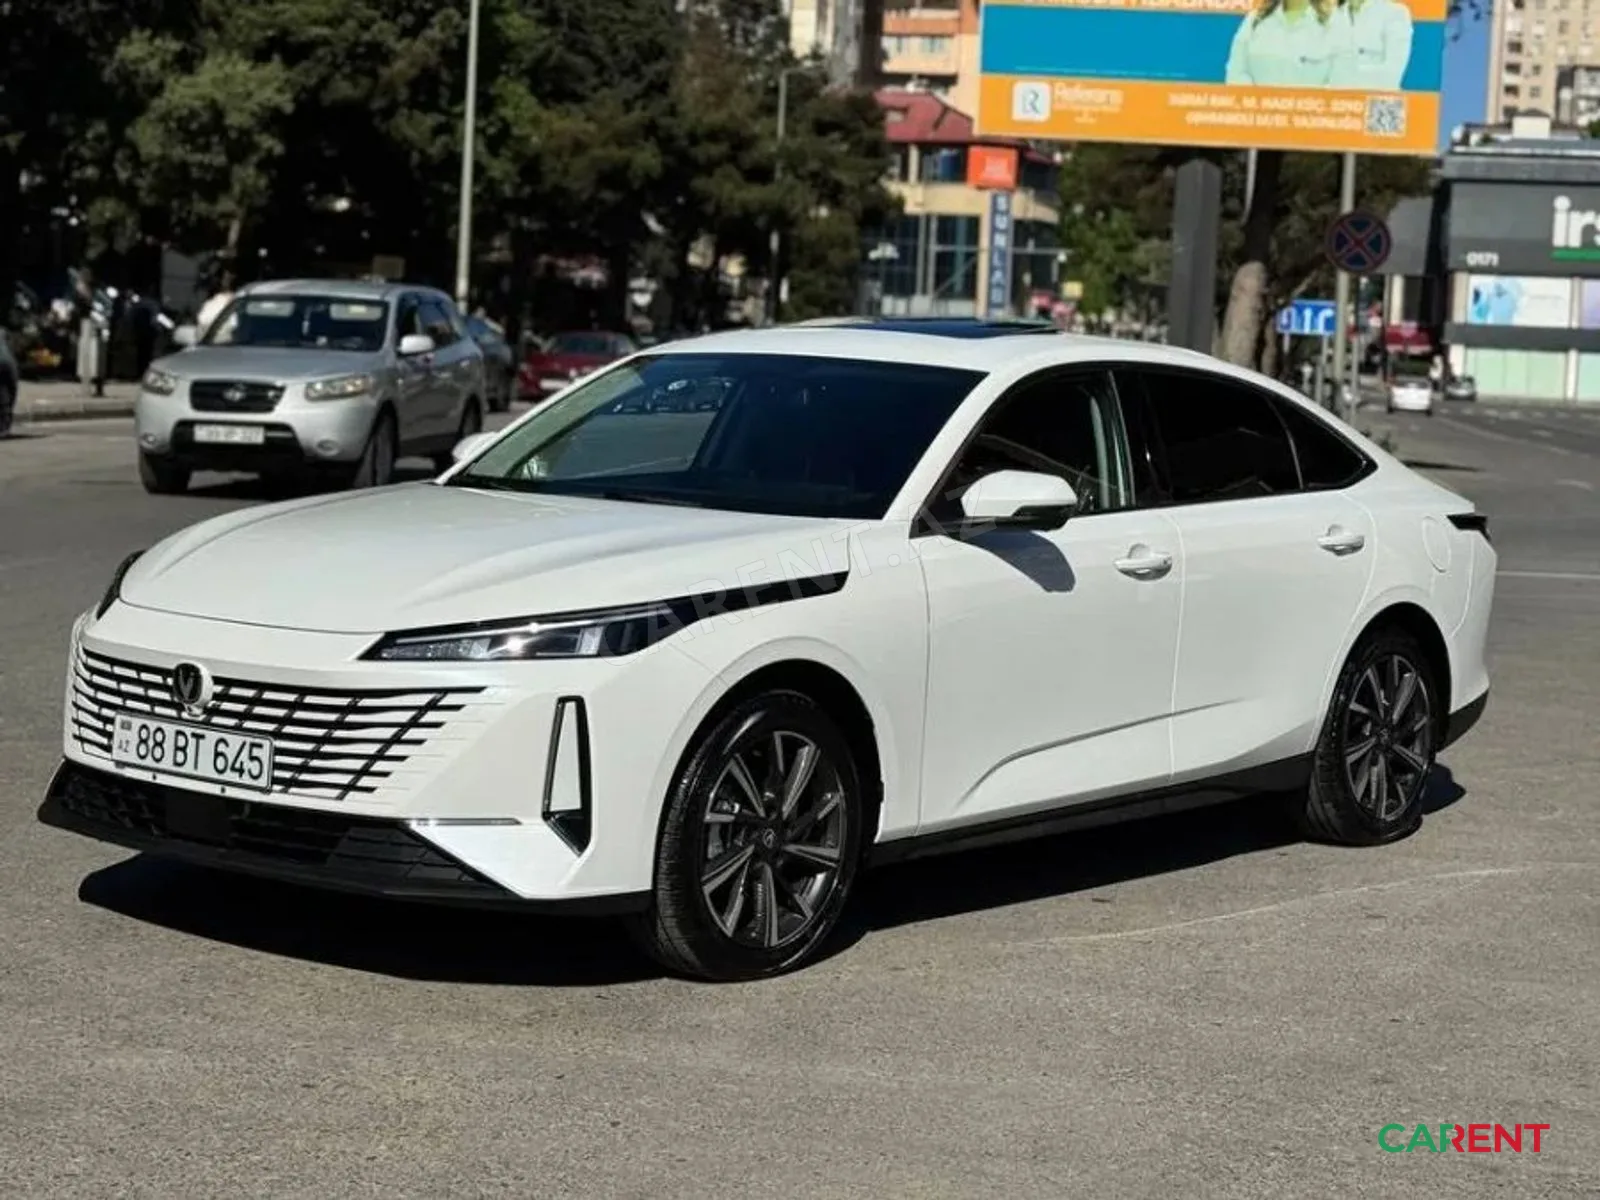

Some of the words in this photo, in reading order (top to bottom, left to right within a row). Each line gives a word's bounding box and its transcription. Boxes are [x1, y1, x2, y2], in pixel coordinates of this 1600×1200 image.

[1552, 194, 1600, 249] ir
[136, 724, 166, 763] 88
[173, 730, 206, 770] BT
[213, 738, 263, 780] 645
